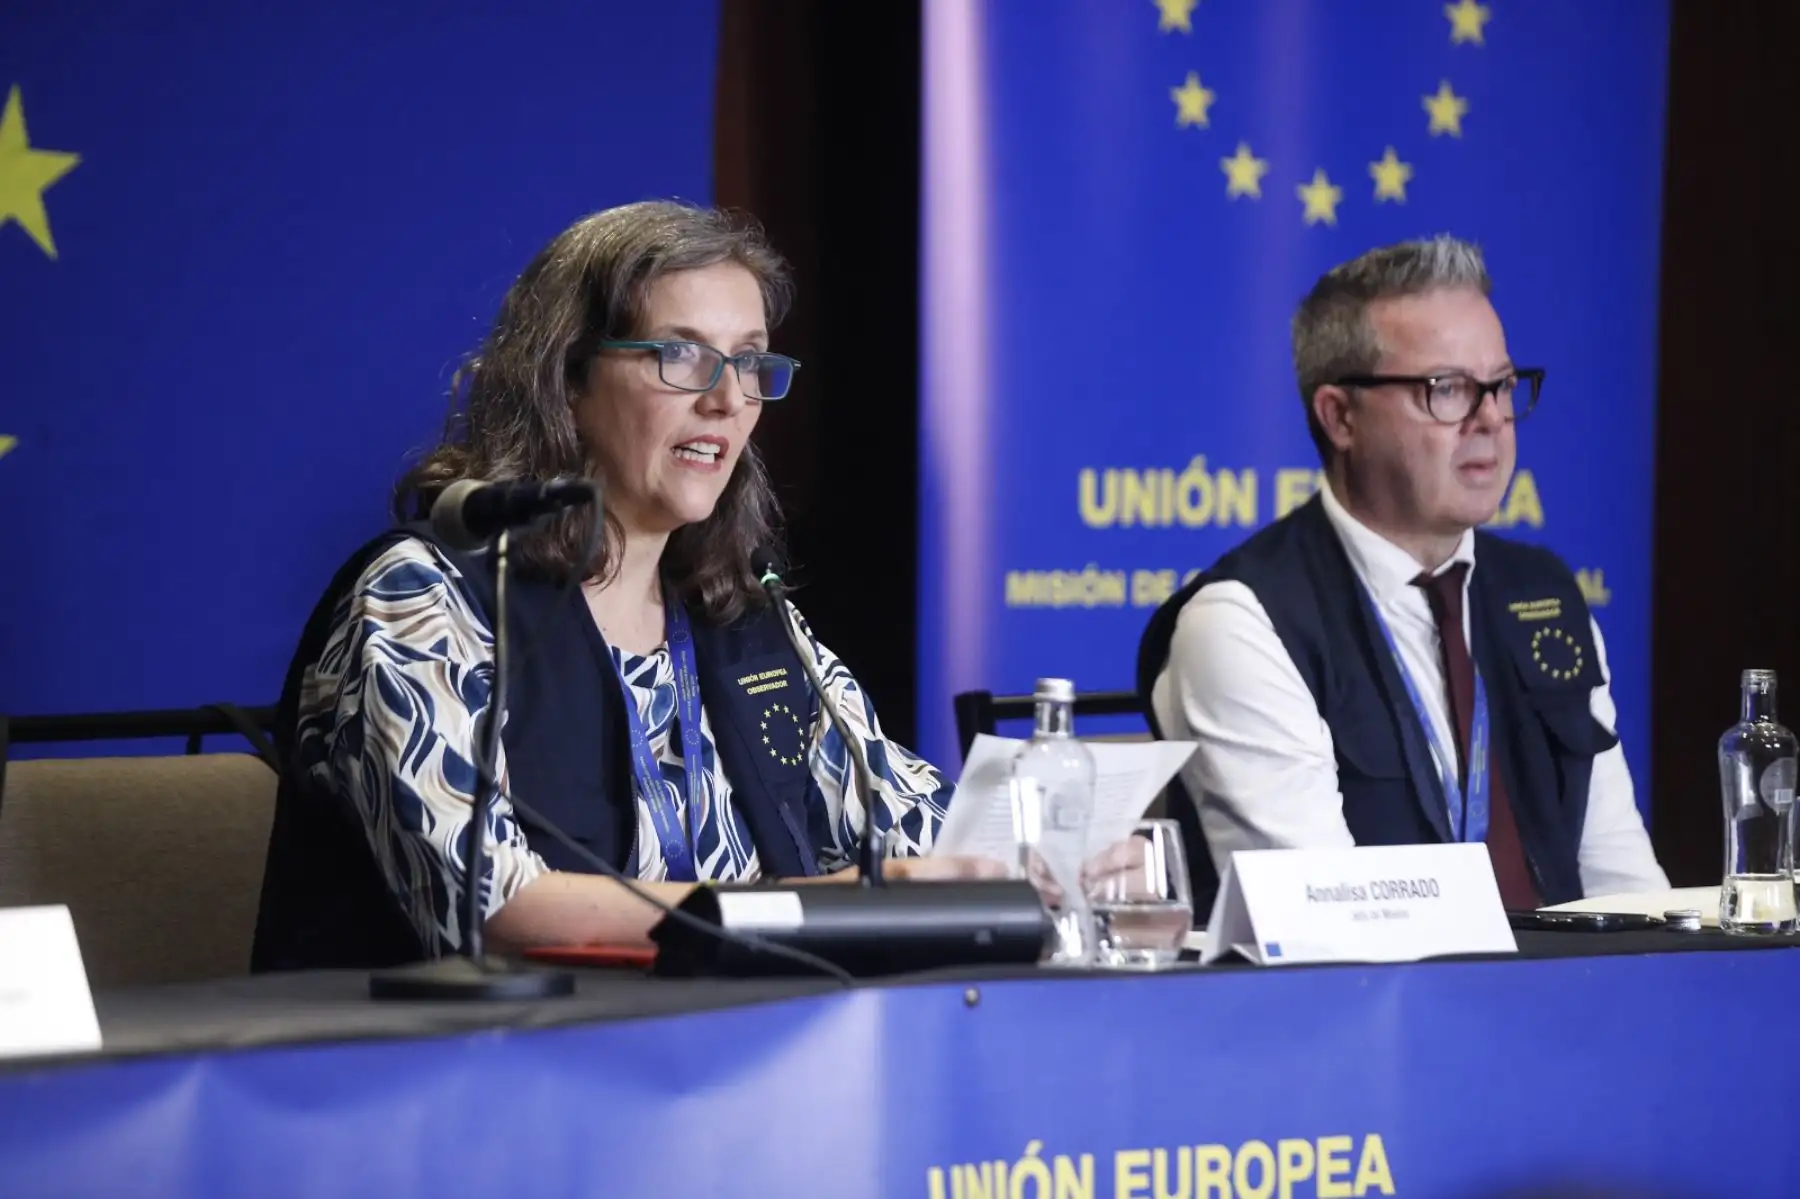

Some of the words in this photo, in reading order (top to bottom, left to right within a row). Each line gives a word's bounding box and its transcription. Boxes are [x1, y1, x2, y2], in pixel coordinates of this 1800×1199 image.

[1078, 454, 1257, 528] UNIÓN
[1006, 562, 1126, 608] MISIÓN
[1132, 569, 1177, 608] DE
[1369, 878, 1440, 900] CORRADO
[1115, 1133, 1396, 1199] EUROPEA
